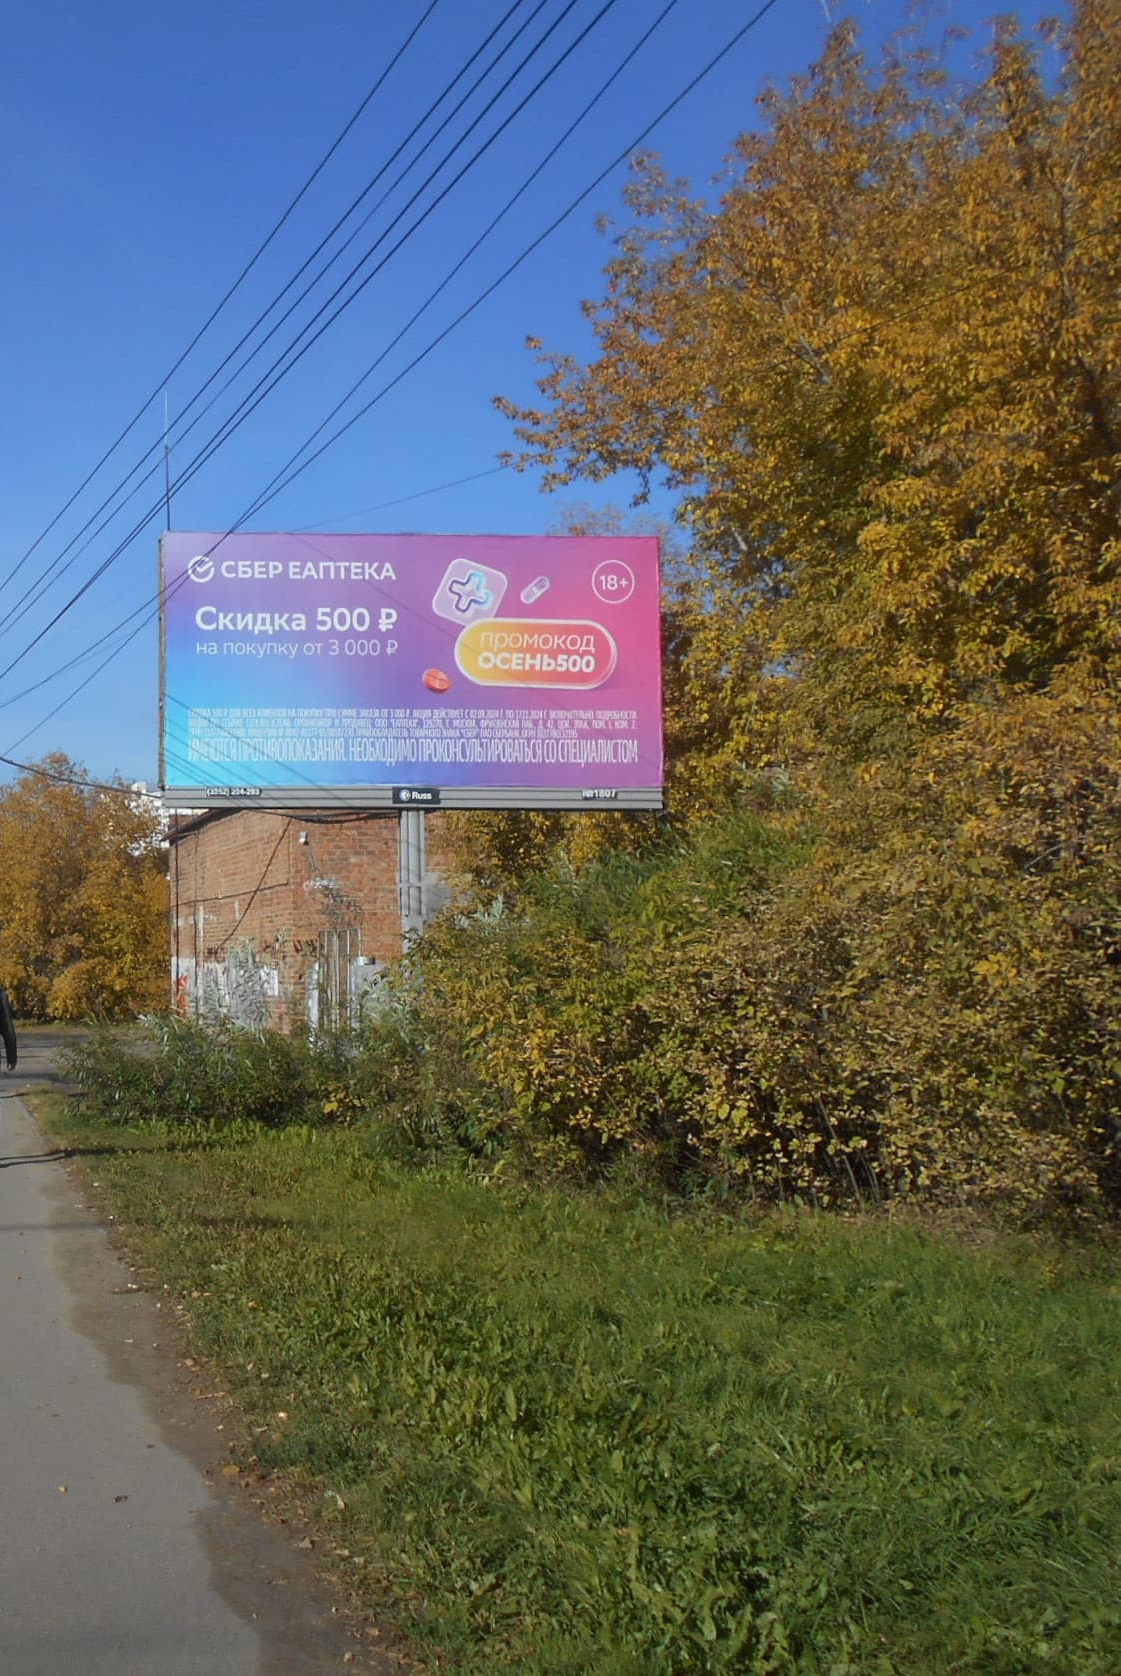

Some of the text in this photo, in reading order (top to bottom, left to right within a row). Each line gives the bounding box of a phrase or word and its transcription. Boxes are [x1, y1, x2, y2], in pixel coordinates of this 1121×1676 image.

[220, 560, 397, 580] СБЕР ЕАПТЕКА
[598, 574, 630, 591] 18+
[195, 605, 307, 634] Скидка
[316, 607, 370, 632] 500
[195, 641, 219, 656] на
[223, 641, 299, 659] покупку
[303, 642, 324, 656] от
[328, 639, 340, 656] 3
[344, 639, 380, 656] 000
[478, 652, 596, 673] ОСЕНЬ500
[349, 738, 417, 766] НЕОБХОДИМО
[419, 739, 542, 763] ПРОКОНСУЛЬТИРОВАТЬСЯ
[544, 740, 557, 763] СО
[559, 740, 639, 768] СПЕЦИАЛИСТОМ
[411, 791, 432, 800] Russ
